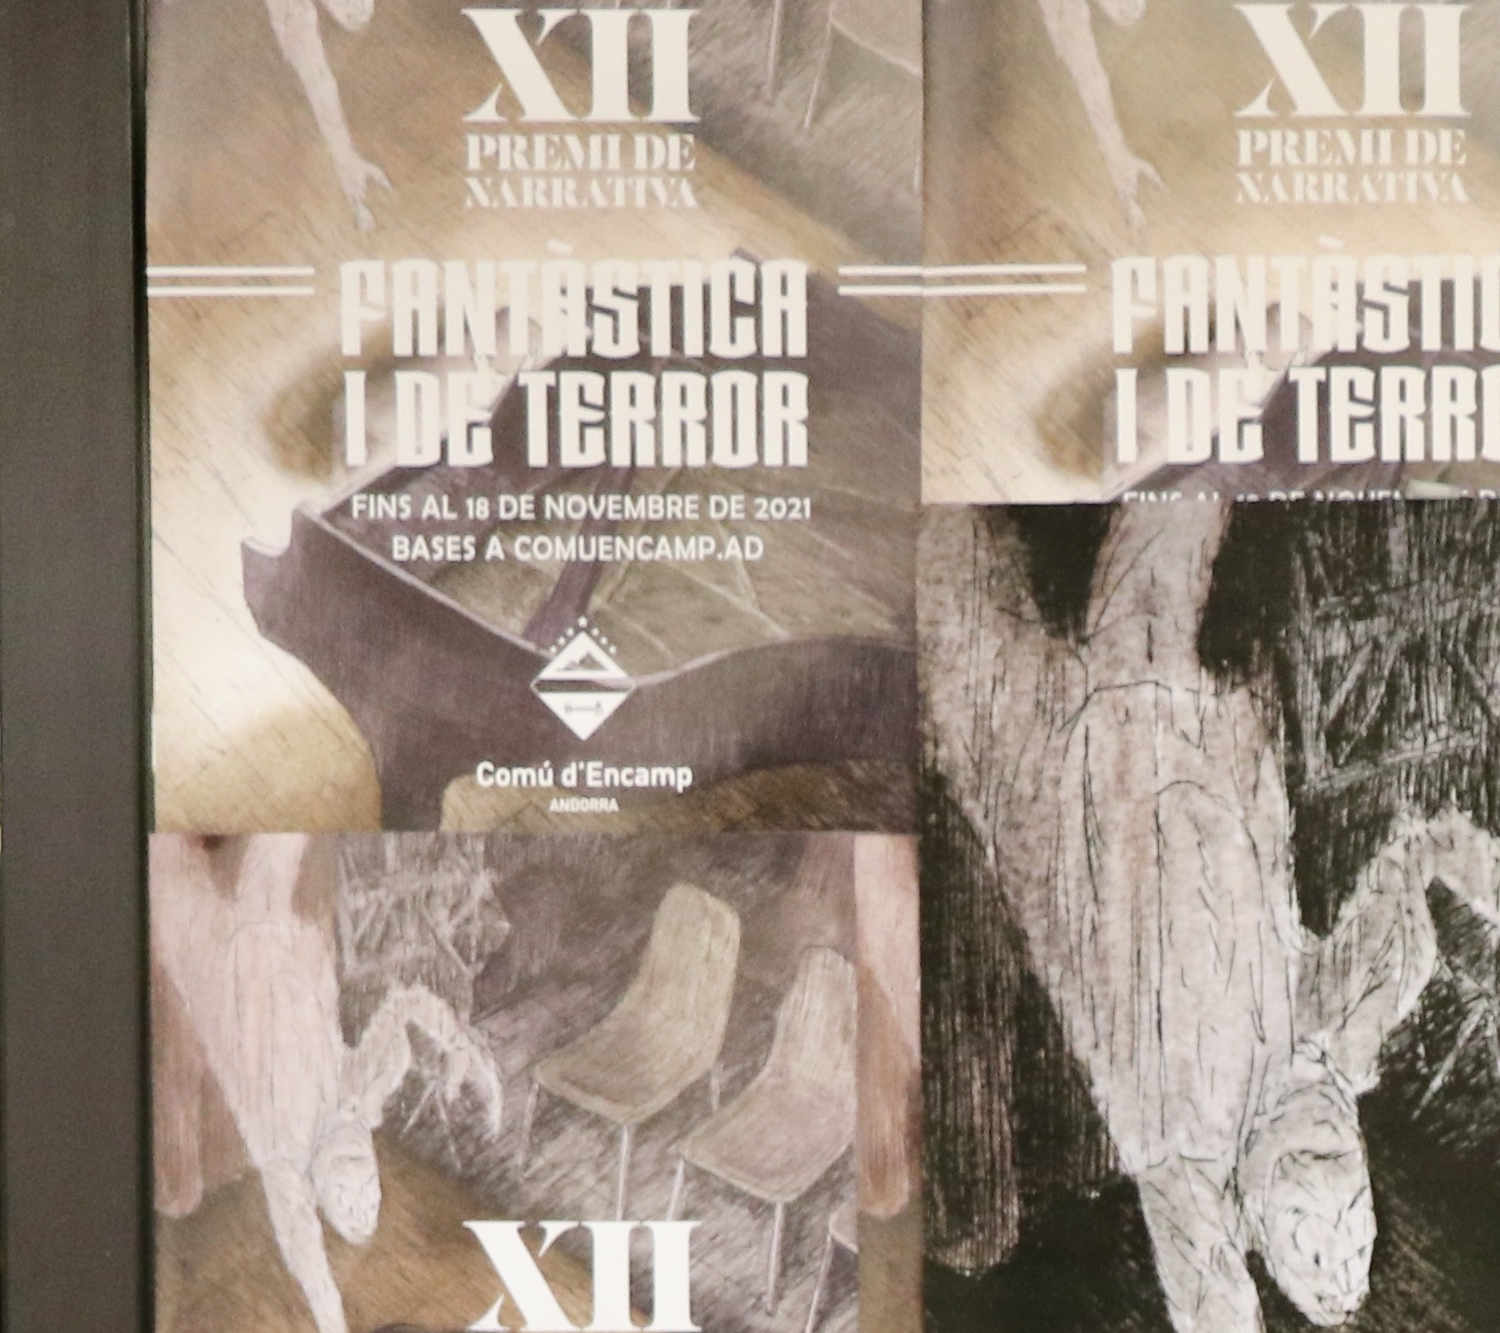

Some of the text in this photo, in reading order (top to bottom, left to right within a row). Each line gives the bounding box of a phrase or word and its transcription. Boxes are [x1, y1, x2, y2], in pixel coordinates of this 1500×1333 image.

[461, 8, 701, 123] XII
[1233, 3, 1473, 119] XII
[464, 132, 696, 172] PREMI DE
[464, 176, 699, 209] NARRATIVA
[340, 240, 809, 357] FANTÀSTICA
[344, 371, 809, 468] I DE TERROR
[1115, 367, 1141, 464] I
[1166, 366, 1264, 464] DE
[352, 494, 812, 521] FINS AL 18 DE NOVEMBRE DE 2021
[391, 535, 764, 562] BASES A COMUENCAMP.AD
[475, 761, 693, 792] Comú d'Encamp
[464, 1220, 702, 1333] XII
